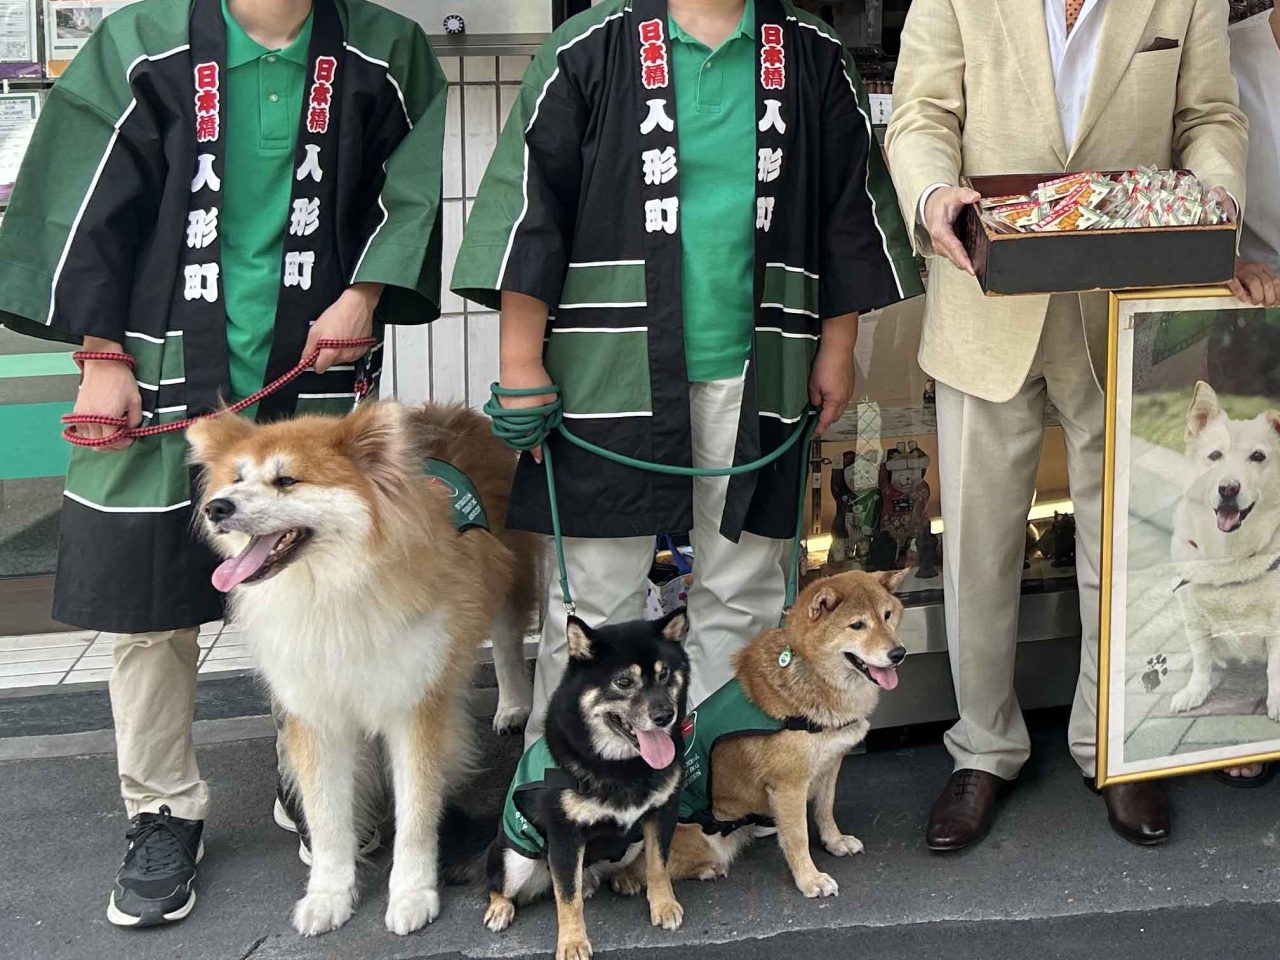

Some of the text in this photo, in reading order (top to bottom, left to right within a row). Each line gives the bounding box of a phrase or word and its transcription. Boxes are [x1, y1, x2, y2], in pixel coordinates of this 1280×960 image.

[184, 61, 221, 302] 日本橋 人形町
[283, 56, 337, 290] 日本橋 人形町
[638, 18, 678, 234] 日本橋 人形町
[756, 23, 786, 232] 日本橋 人形町
